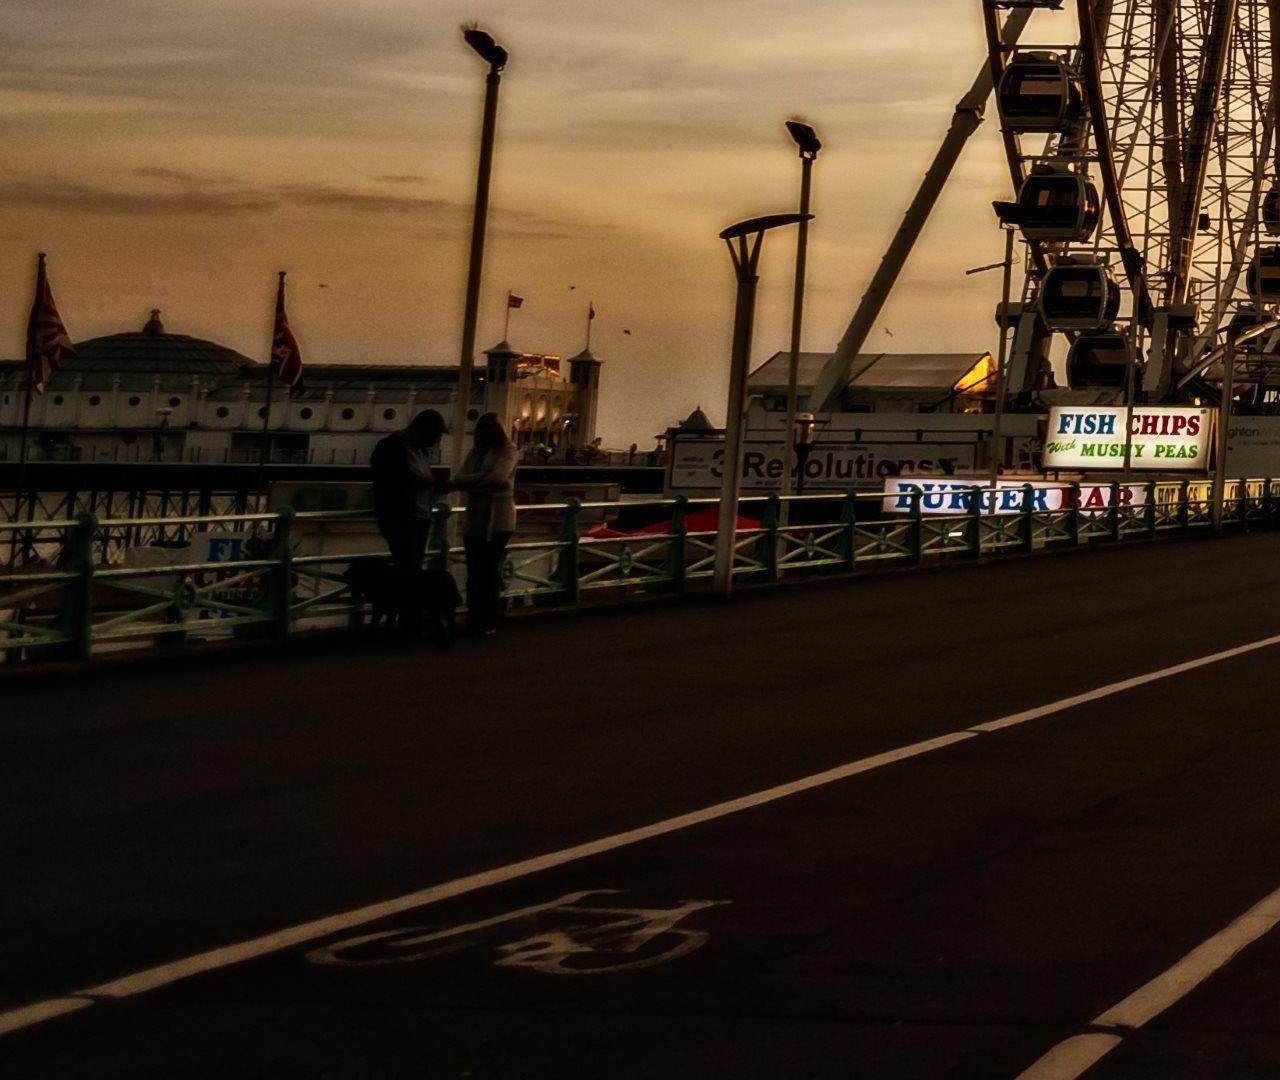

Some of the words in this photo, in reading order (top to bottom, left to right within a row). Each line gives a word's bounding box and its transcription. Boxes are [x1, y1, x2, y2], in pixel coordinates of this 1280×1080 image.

[1057, 414, 1117, 435] FISH
[1129, 414, 1201, 436] CHIPS
[1046, 439, 1077, 454] With
[1154, 444, 1199, 459] PEAS
[711, 449, 725, 478] 3
[895, 483, 1050, 511] BURGER
[1058, 486, 1135, 512] BAR
